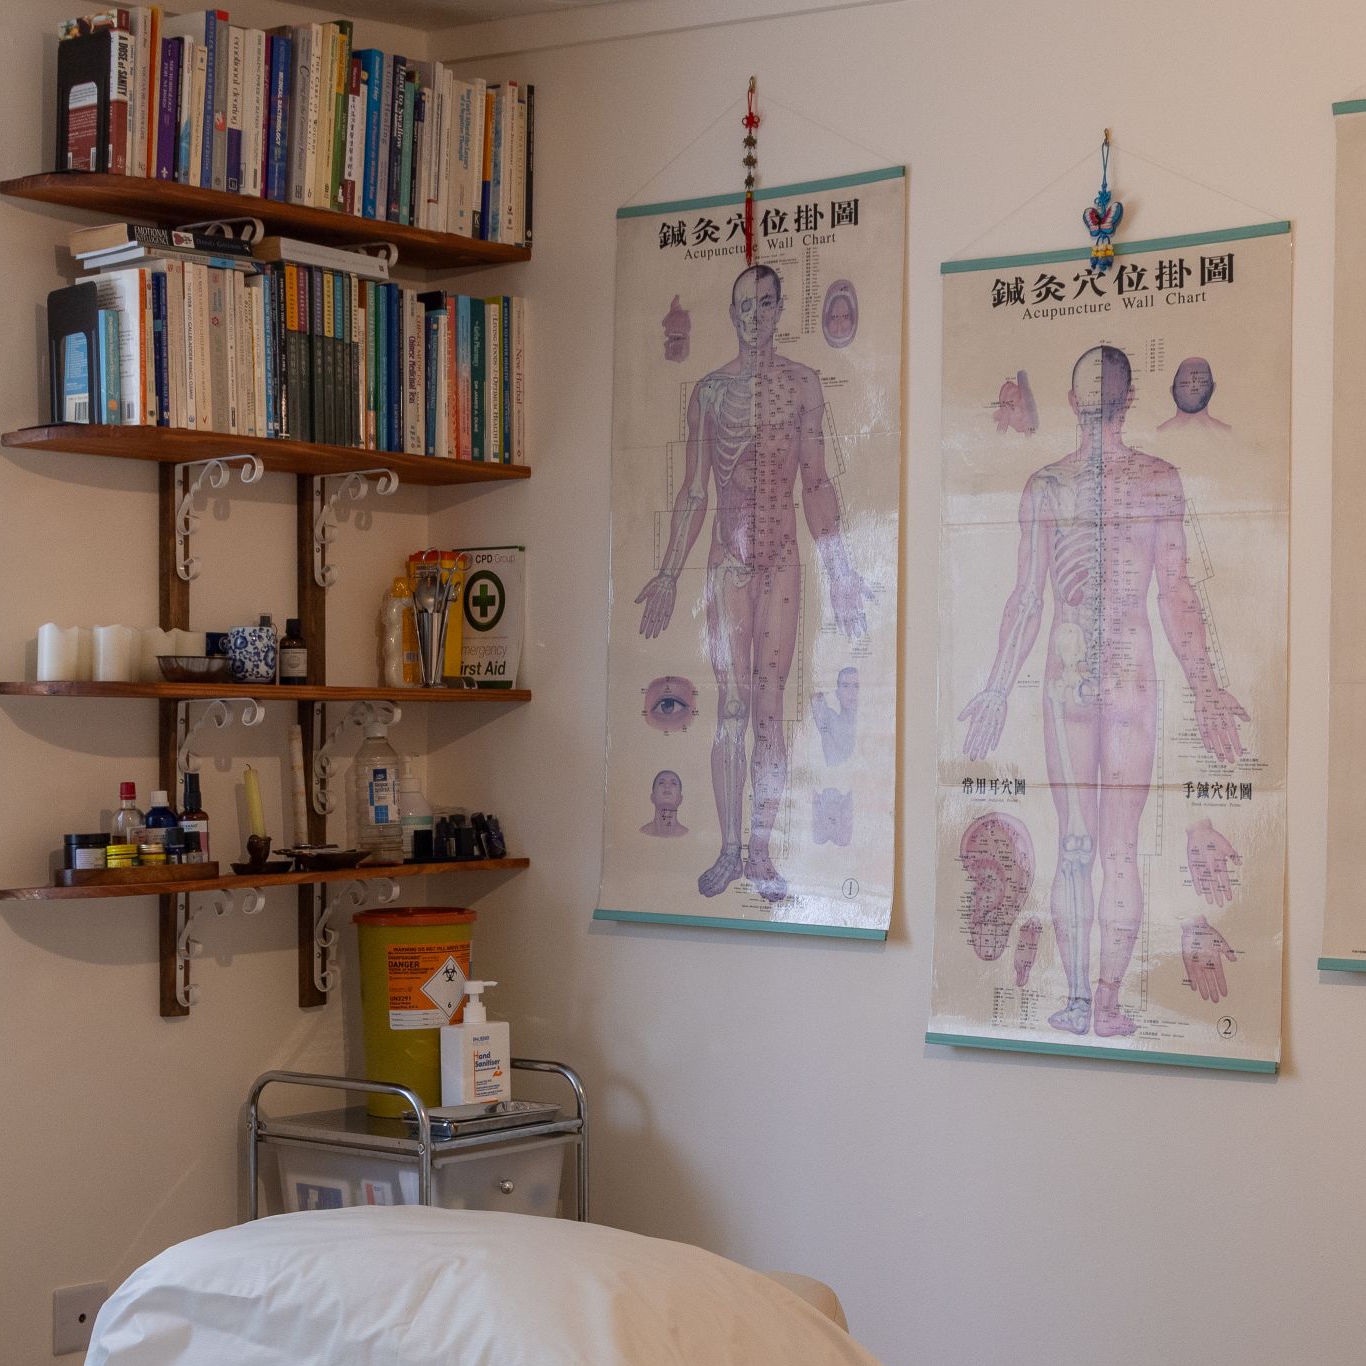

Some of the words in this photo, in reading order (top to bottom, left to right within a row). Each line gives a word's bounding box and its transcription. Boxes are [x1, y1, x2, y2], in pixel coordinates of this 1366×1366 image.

[117, 42, 128, 60] DOSE
[231, 36, 241, 84] emotional
[116, 69, 128, 96] SANITY
[398, 65, 406, 91] Hard
[230, 87, 239, 124] clearing
[398, 95, 405, 105] to
[396, 107, 404, 149] Swallow
[135, 225, 167, 237] EMOTIONAL
[684, 244, 758, 260] Acupunctue
[767, 237, 793, 250] Wall
[803, 233, 836, 246] Chart
[1023, 303, 1111, 320] Acupuncture
[1122, 295, 1154, 310] Wall
[1166, 291, 1207, 305] Chart
[408, 335, 416, 358] Chinese
[408, 360, 416, 389] Medicinal
[408, 391, 416, 403] Teas
[476, 554, 492, 563] CPD
[495, 554, 515, 566] Group
[463, 645, 507, 658] mergency
[461, 662, 481, 675] irst
[485, 661, 506, 675] Aid
[962, 777, 1026, 795] 常用耳穴圖
[474, 1050, 491, 1060] Hand
[475, 1059, 500, 1067] Sanitiser
